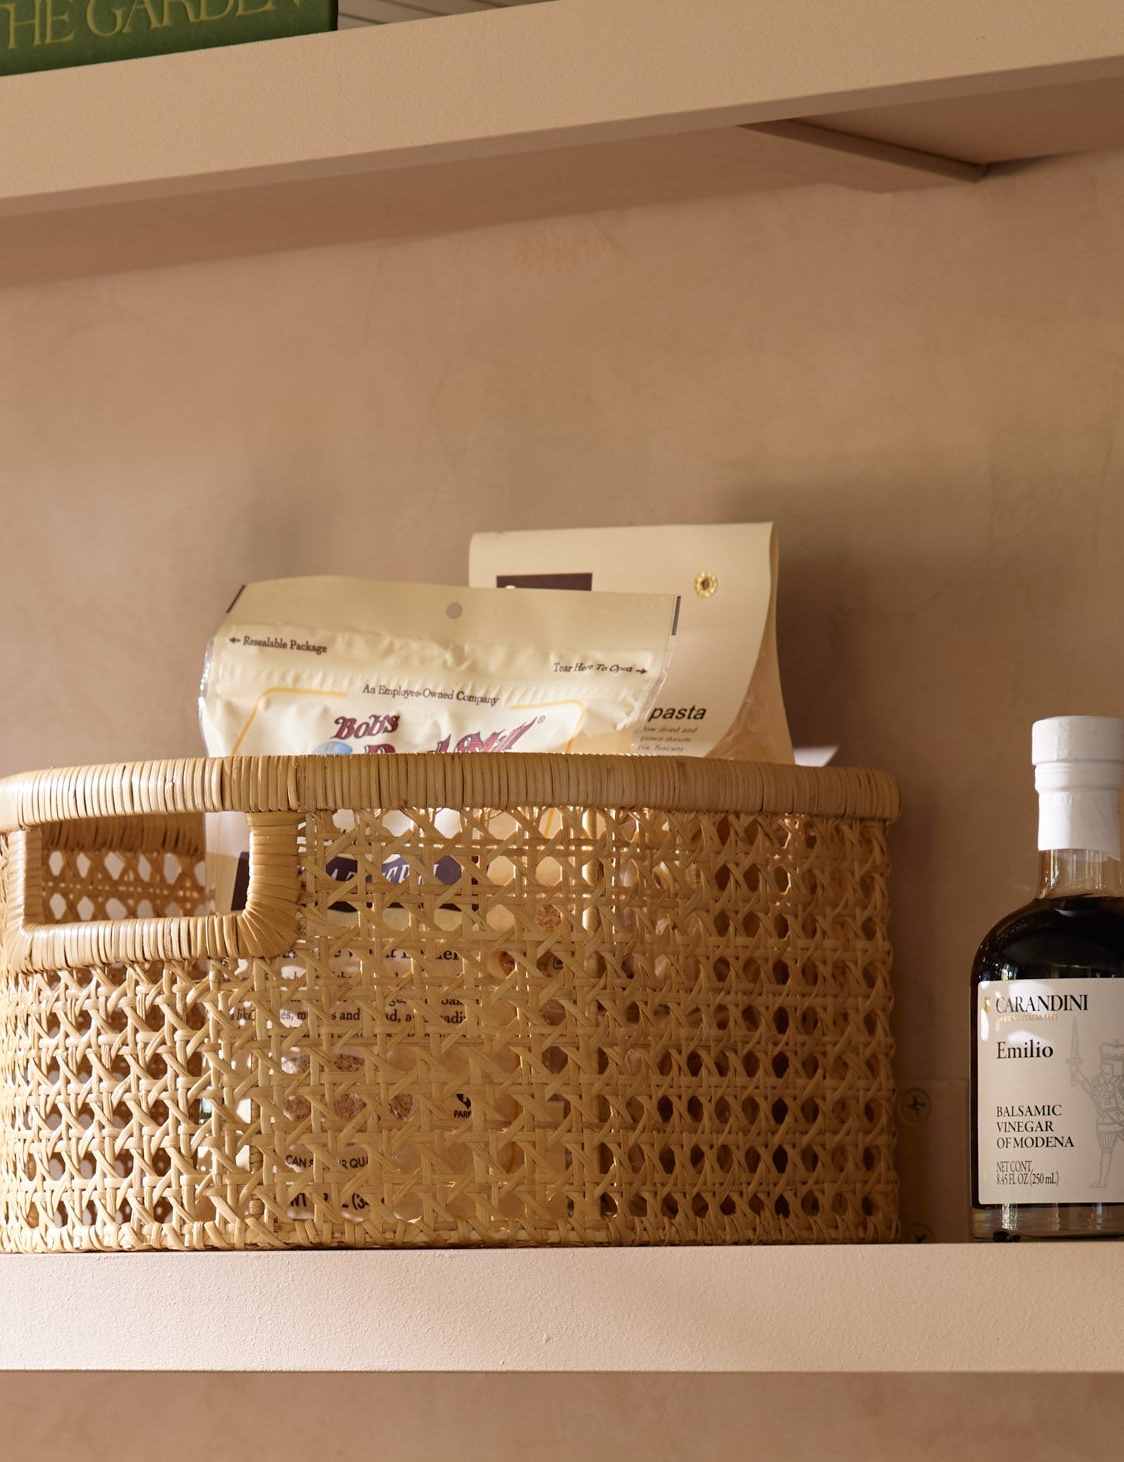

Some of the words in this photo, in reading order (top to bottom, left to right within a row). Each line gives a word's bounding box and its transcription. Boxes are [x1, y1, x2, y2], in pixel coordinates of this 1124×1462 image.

[243, 636, 287, 650] Resealable
[289, 639, 328, 656] Package
[553, 662, 573, 673] Tear
[362, 684, 376, 694] An
[378, 685, 455, 701] Employee-Owned
[456, 691, 500, 707] Company
[647, 705, 707, 722] pasta
[995, 995, 1089, 1013] CARANDINI
[996, 1039, 1054, 1059] Emilio
[996, 1104, 1062, 1117] BALSAMIC
[996, 1120, 1054, 1133] VINEGAR
[996, 1137, 1012, 1149] OF
[1013, 1136, 1075, 1149] MODENA
[996, 1161, 1009, 1172] NET
[1009, 1173, 1017, 1185] FL
[1018, 1173, 1029, 1185] OZ
[1029, 1171, 1044, 1186] (250
[1045, 1170, 1060, 1187] mL)
